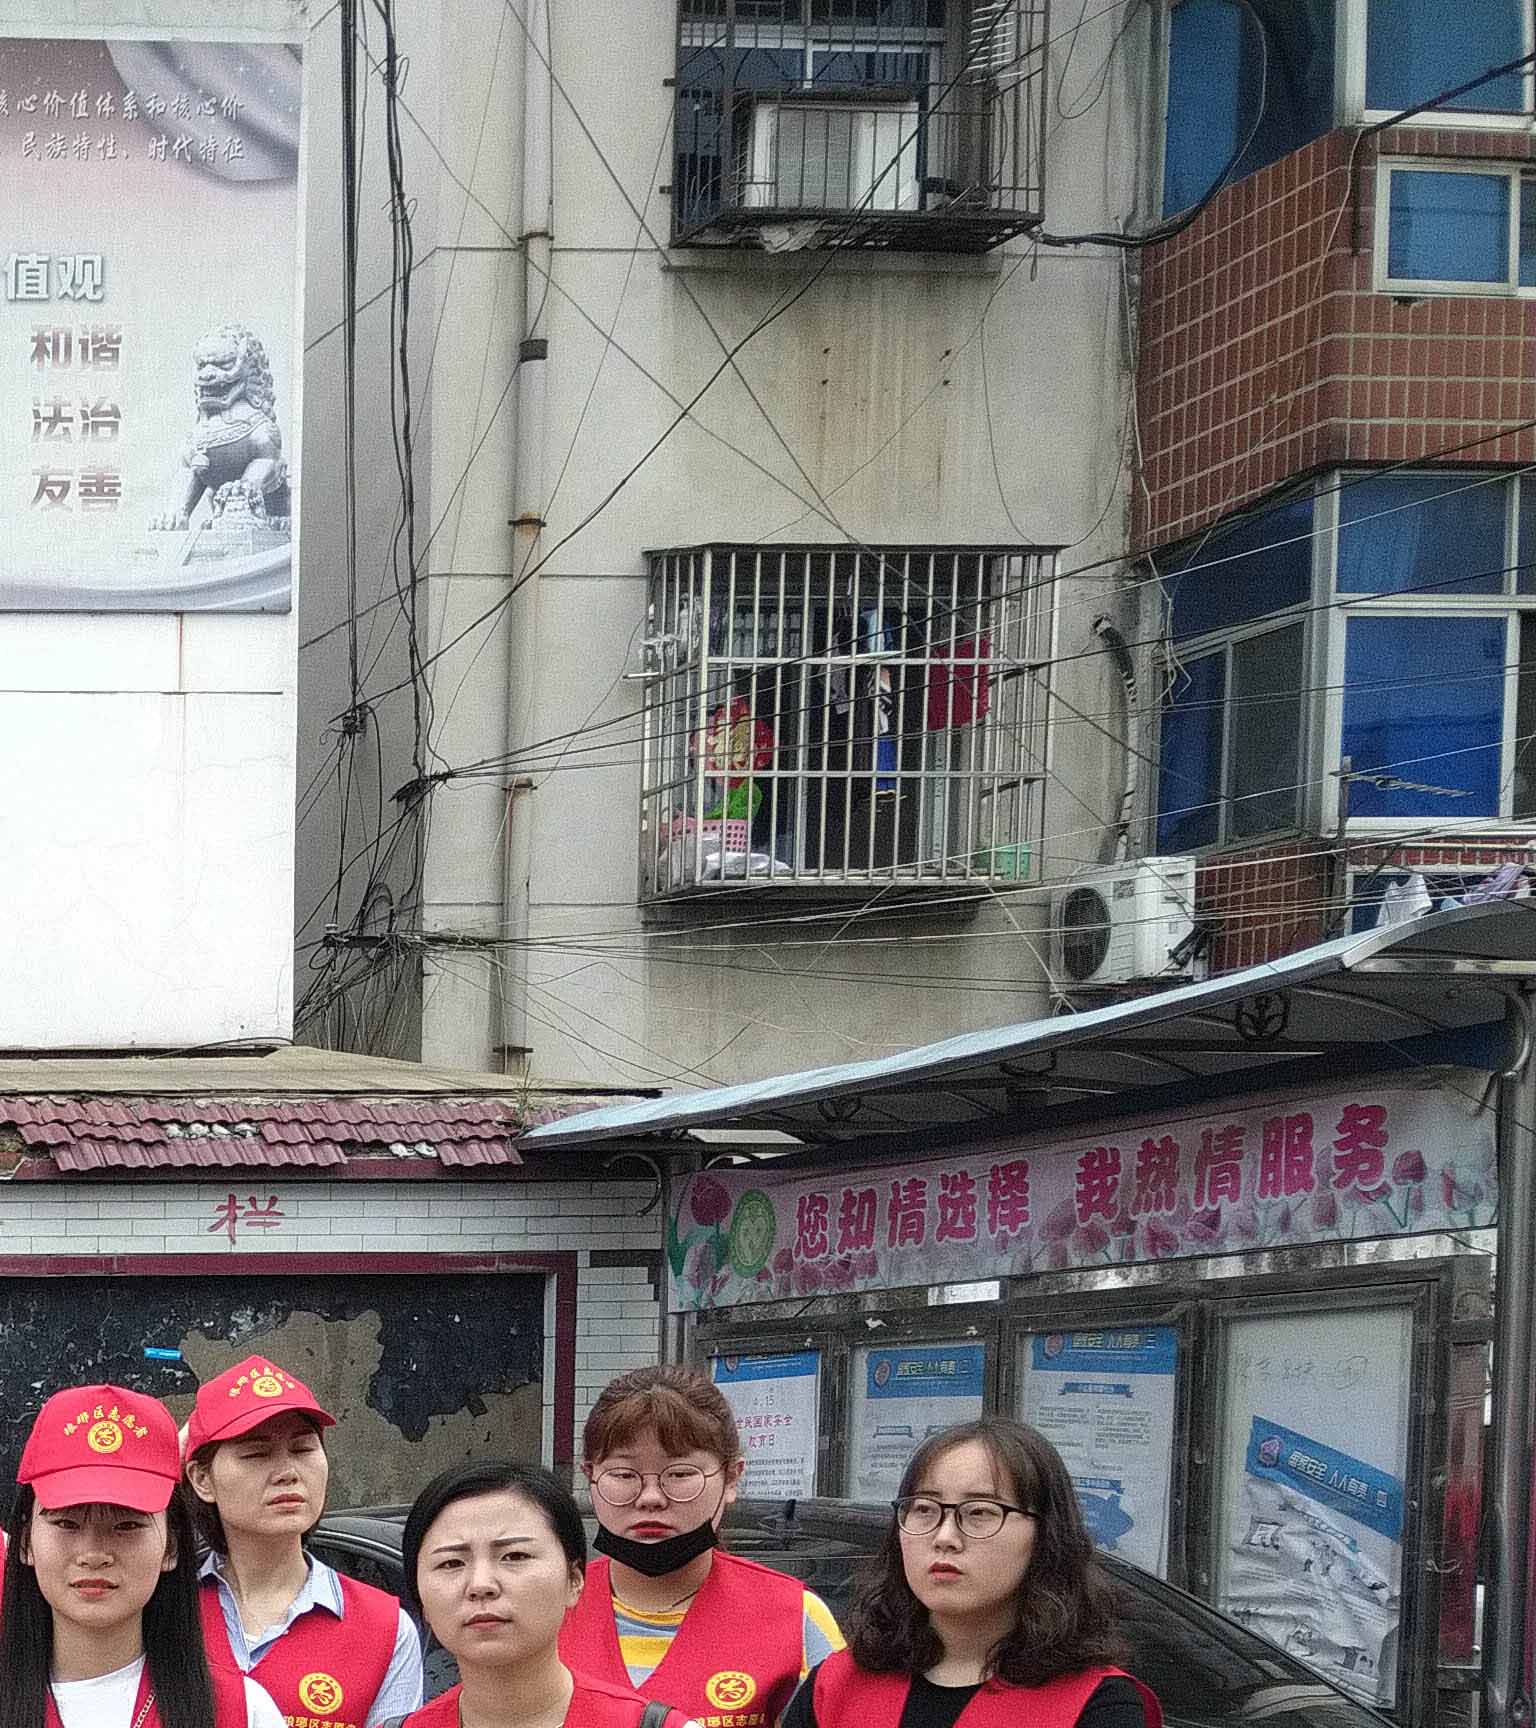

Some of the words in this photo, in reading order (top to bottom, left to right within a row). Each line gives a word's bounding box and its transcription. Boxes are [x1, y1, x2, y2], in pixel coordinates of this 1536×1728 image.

[29, 324, 123, 373] 和谐
[30, 396, 122, 445] 法治
[30, 466, 123, 514] 友善
[793, 1160, 1031, 1263] 您知情选择
[1074, 1102, 1390, 1226] 我热情服务
